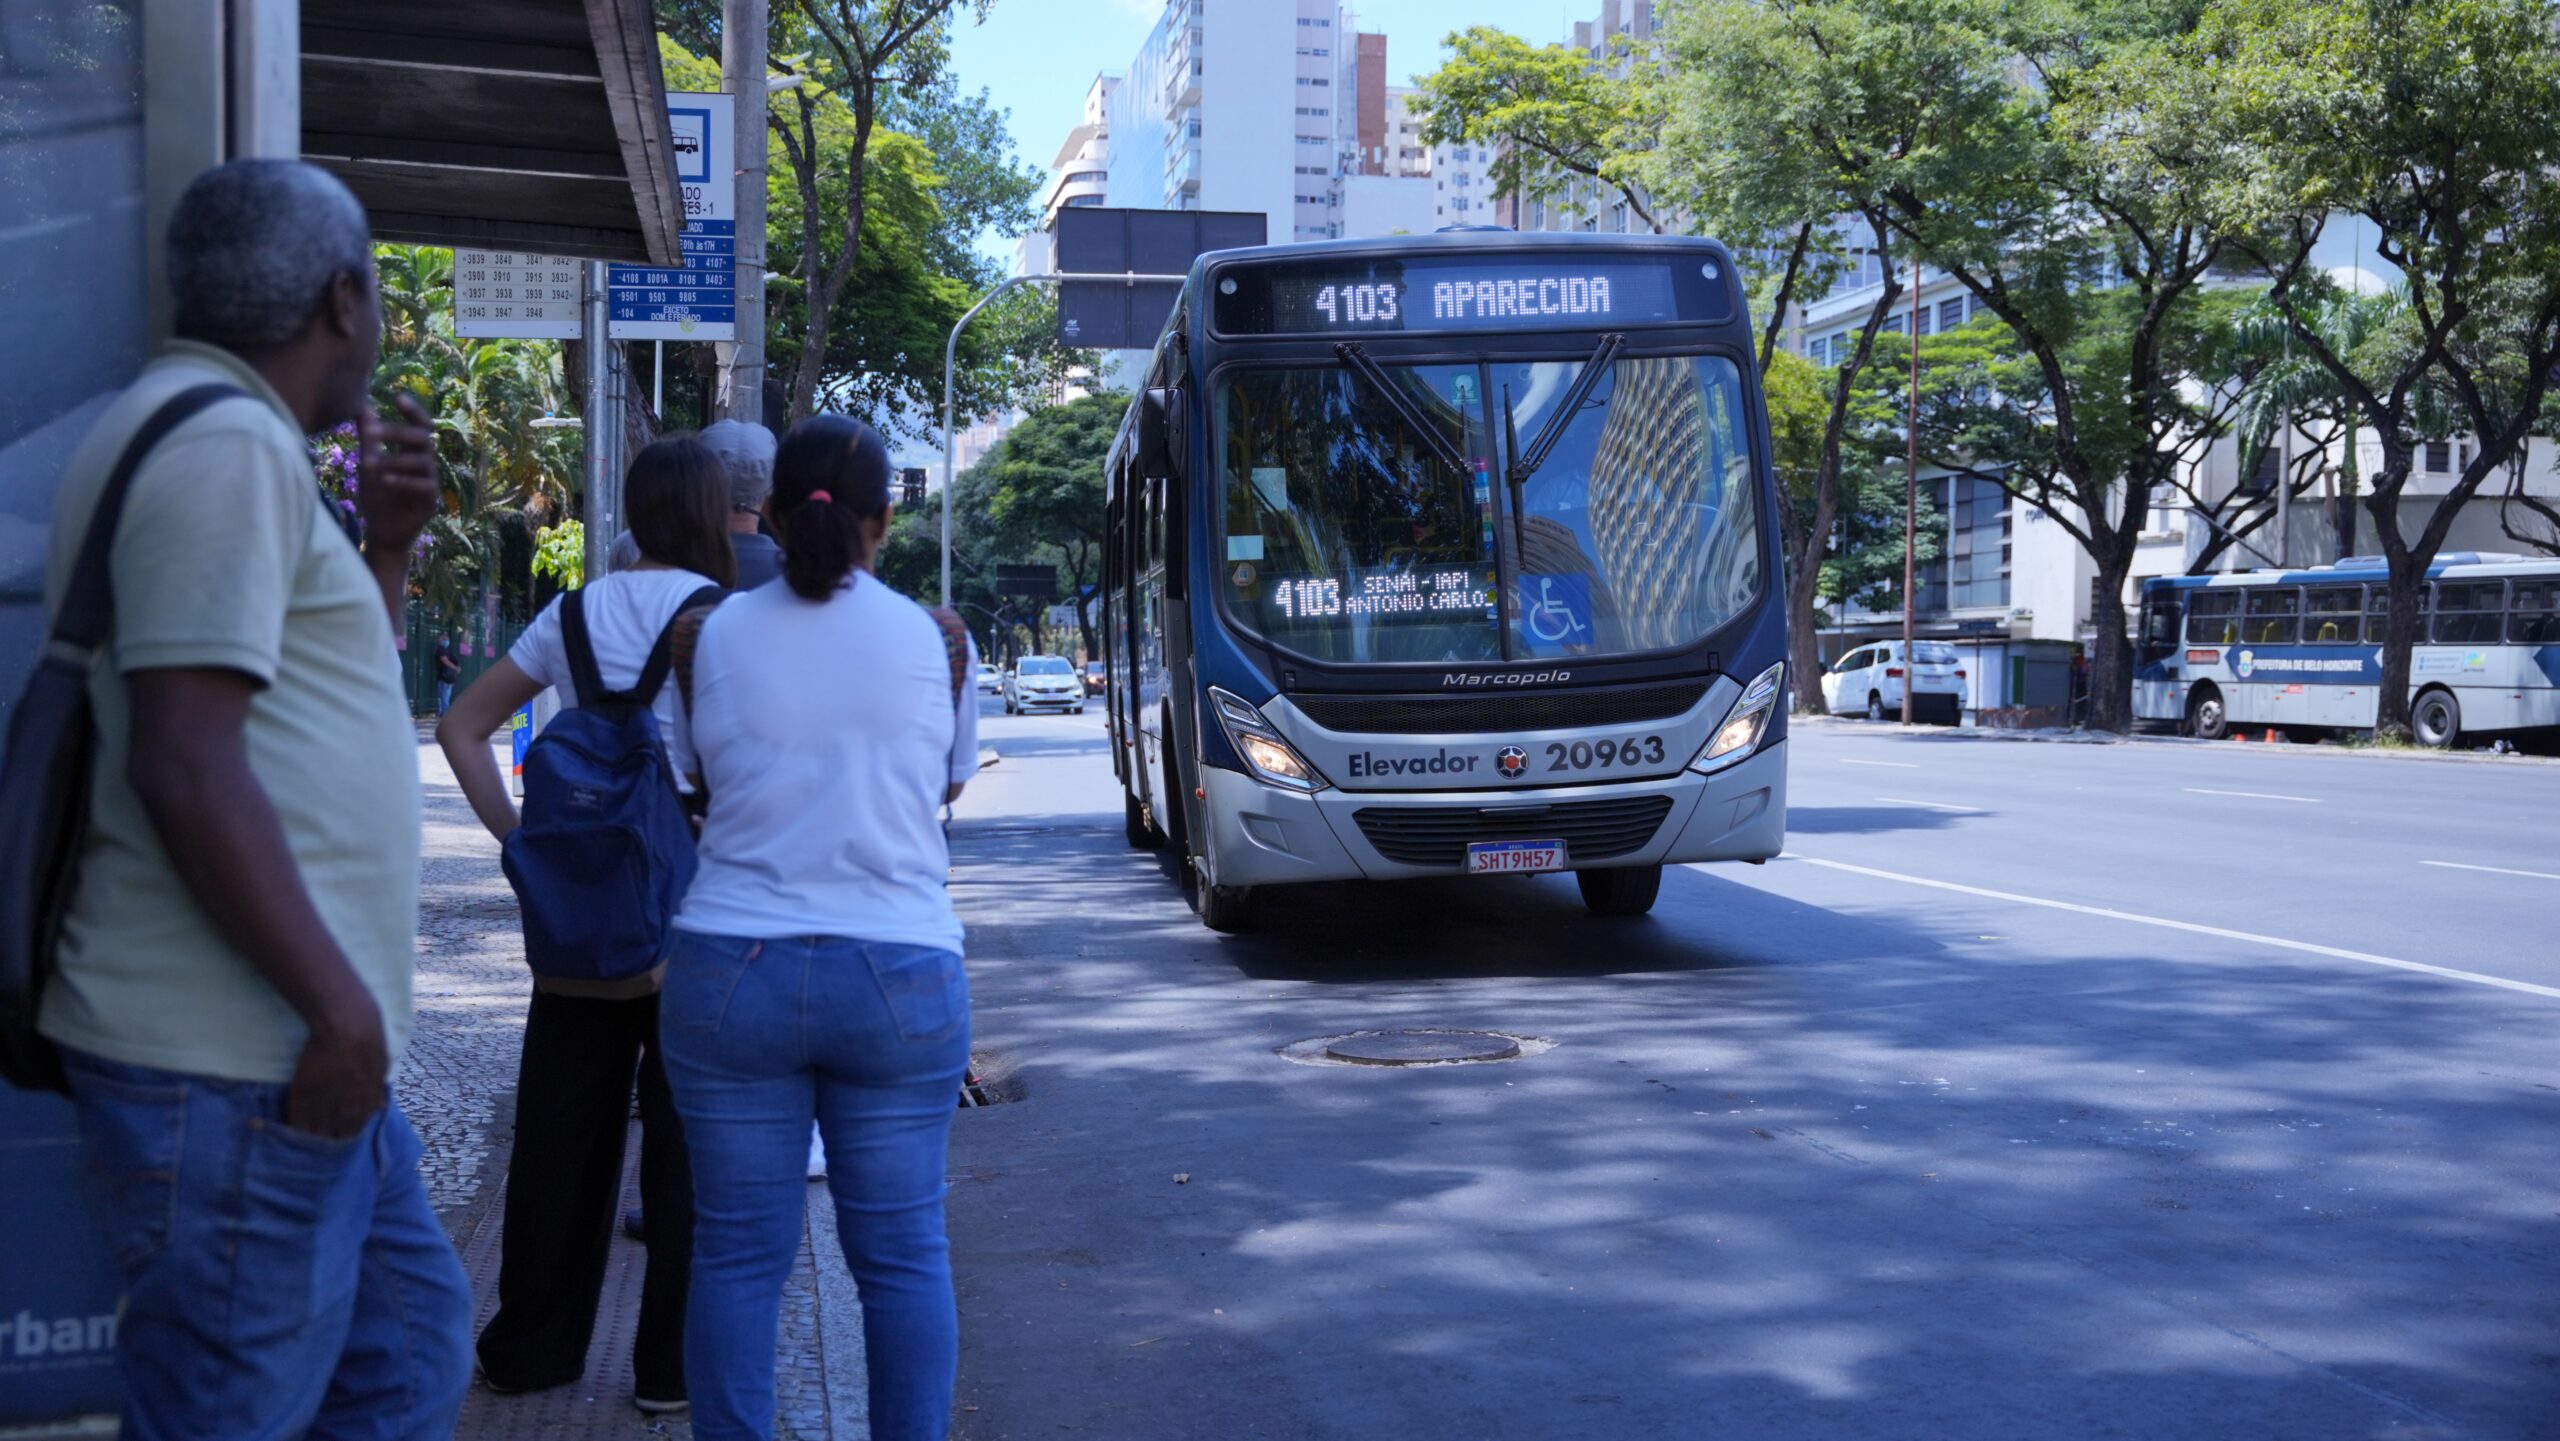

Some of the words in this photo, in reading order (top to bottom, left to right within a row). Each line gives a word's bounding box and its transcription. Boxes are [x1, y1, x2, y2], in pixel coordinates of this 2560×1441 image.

[467, 254, 485, 264] 3839
[495, 254, 513, 264] 3840
[526, 255, 543, 265] 3841
[705, 258, 723, 268] 4107
[468, 271, 485, 281] 3900
[493, 271, 511, 281] 3910
[525, 272, 543, 282] 3915
[551, 273, 569, 282] 3933
[621, 273, 639, 283] 4108
[705, 275, 723, 285] 9403
[468, 288, 486, 298] 3937
[495, 288, 513, 298] 3938
[525, 289, 543, 299] 3939
[552, 290, 569, 300] 3942
[621, 292, 638, 302] 9501
[648, 292, 666, 302] 9503
[1316, 284, 1397, 322] 4103
[1433, 276, 1611, 319] APARECIDA
[468, 307, 486, 317] 3943
[495, 307, 512, 318] 3947
[525, 307, 543, 318] 3948
[621, 308, 634, 318] 104
[663, 306, 689, 314] EXCETO
[1363, 574, 1416, 594] SENAI
[1435, 571, 1469, 590] IAPI
[1275, 578, 1341, 617] 4103
[1345, 593, 1424, 614] ANTONIO
[2252, 659, 2293, 671] PREFEITURA
[2293, 659, 2303, 671] DE
[2304, 659, 2322, 671] BELO
[2323, 659, 2364, 672] HORIZONTE
[1442, 669, 1571, 687] Marcopolo
[1545, 735, 1666, 772] 20963
[1348, 748, 1479, 777] Elevador
[1478, 850, 1555, 870] SHT9H57
